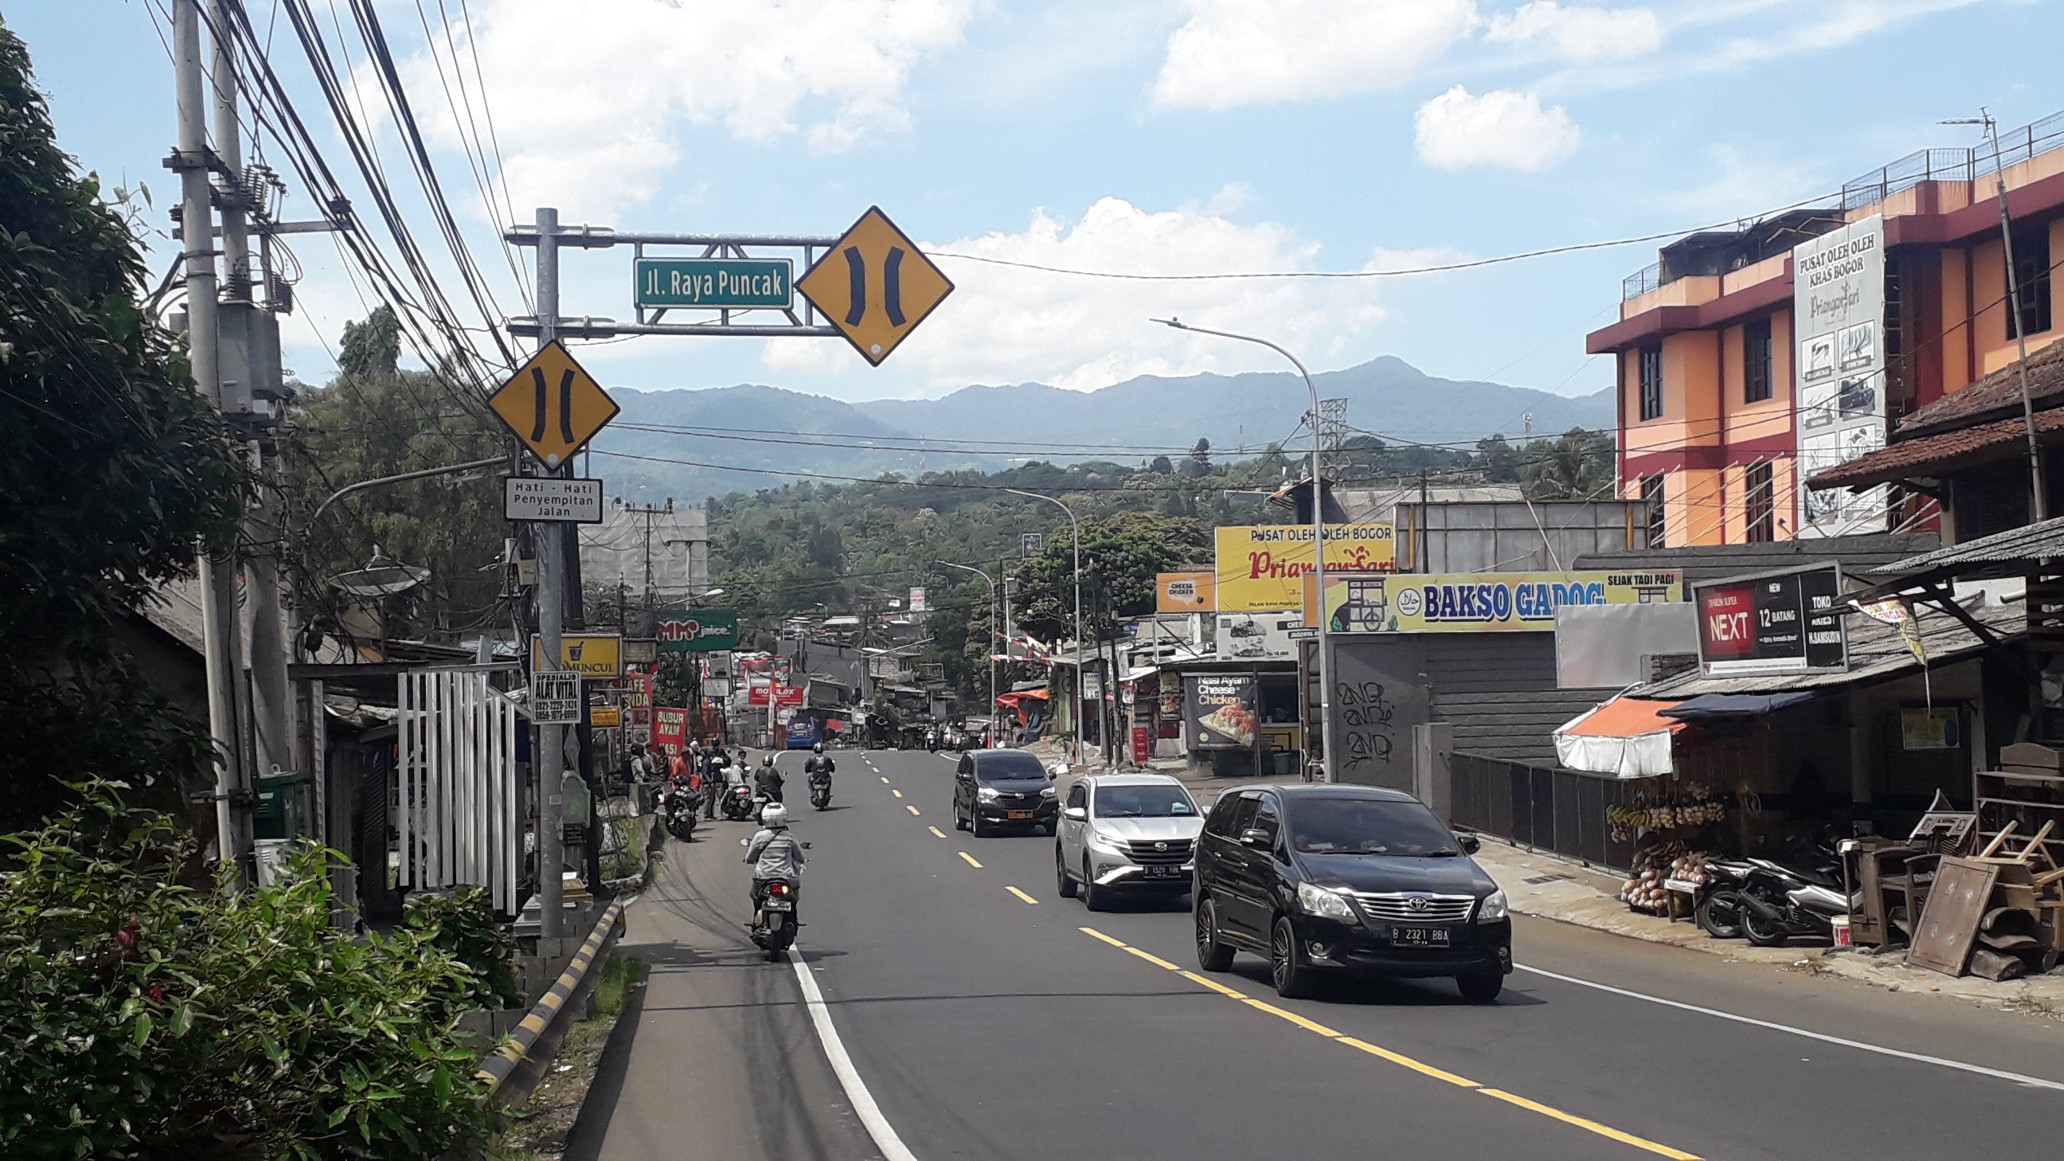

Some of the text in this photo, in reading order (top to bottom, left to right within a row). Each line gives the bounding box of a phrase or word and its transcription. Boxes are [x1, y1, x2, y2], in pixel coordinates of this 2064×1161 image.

[1800, 233, 1875, 274] PUSAT OLEH OLEH
[1810, 256, 1864, 288] KHAS BOGOR
[645, 268, 783, 303] Jl. Raya Puncak
[515, 482, 544, 492] Hati
[564, 484, 592, 494] Hati
[514, 494, 593, 507] Penyempitan
[538, 507, 570, 516] Jalan
[1251, 529, 1285, 541] PUSAT
[1287, 529, 1316, 540] OLEH
[1353, 527, 1393, 540] BOGOR
[1607, 574, 1675, 586] SEJAK TADI PAGI
[1423, 582, 1607, 619] BAKSO GADOG
[1811, 595, 1832, 609] TOKO
[1759, 608, 1796, 627] 12 BATANG
[1709, 611, 1749, 641] NEXT
[1197, 676, 1250, 687] Nasi Ayam
[535, 680, 577, 700] ALAT VITAL
[1197, 685, 1236, 695] Cheese
[1198, 694, 1241, 705] Chicken
[658, 724, 681, 736] AYAM
[1392, 928, 1399, 940] B
[1405, 928, 1427, 940] 2321
